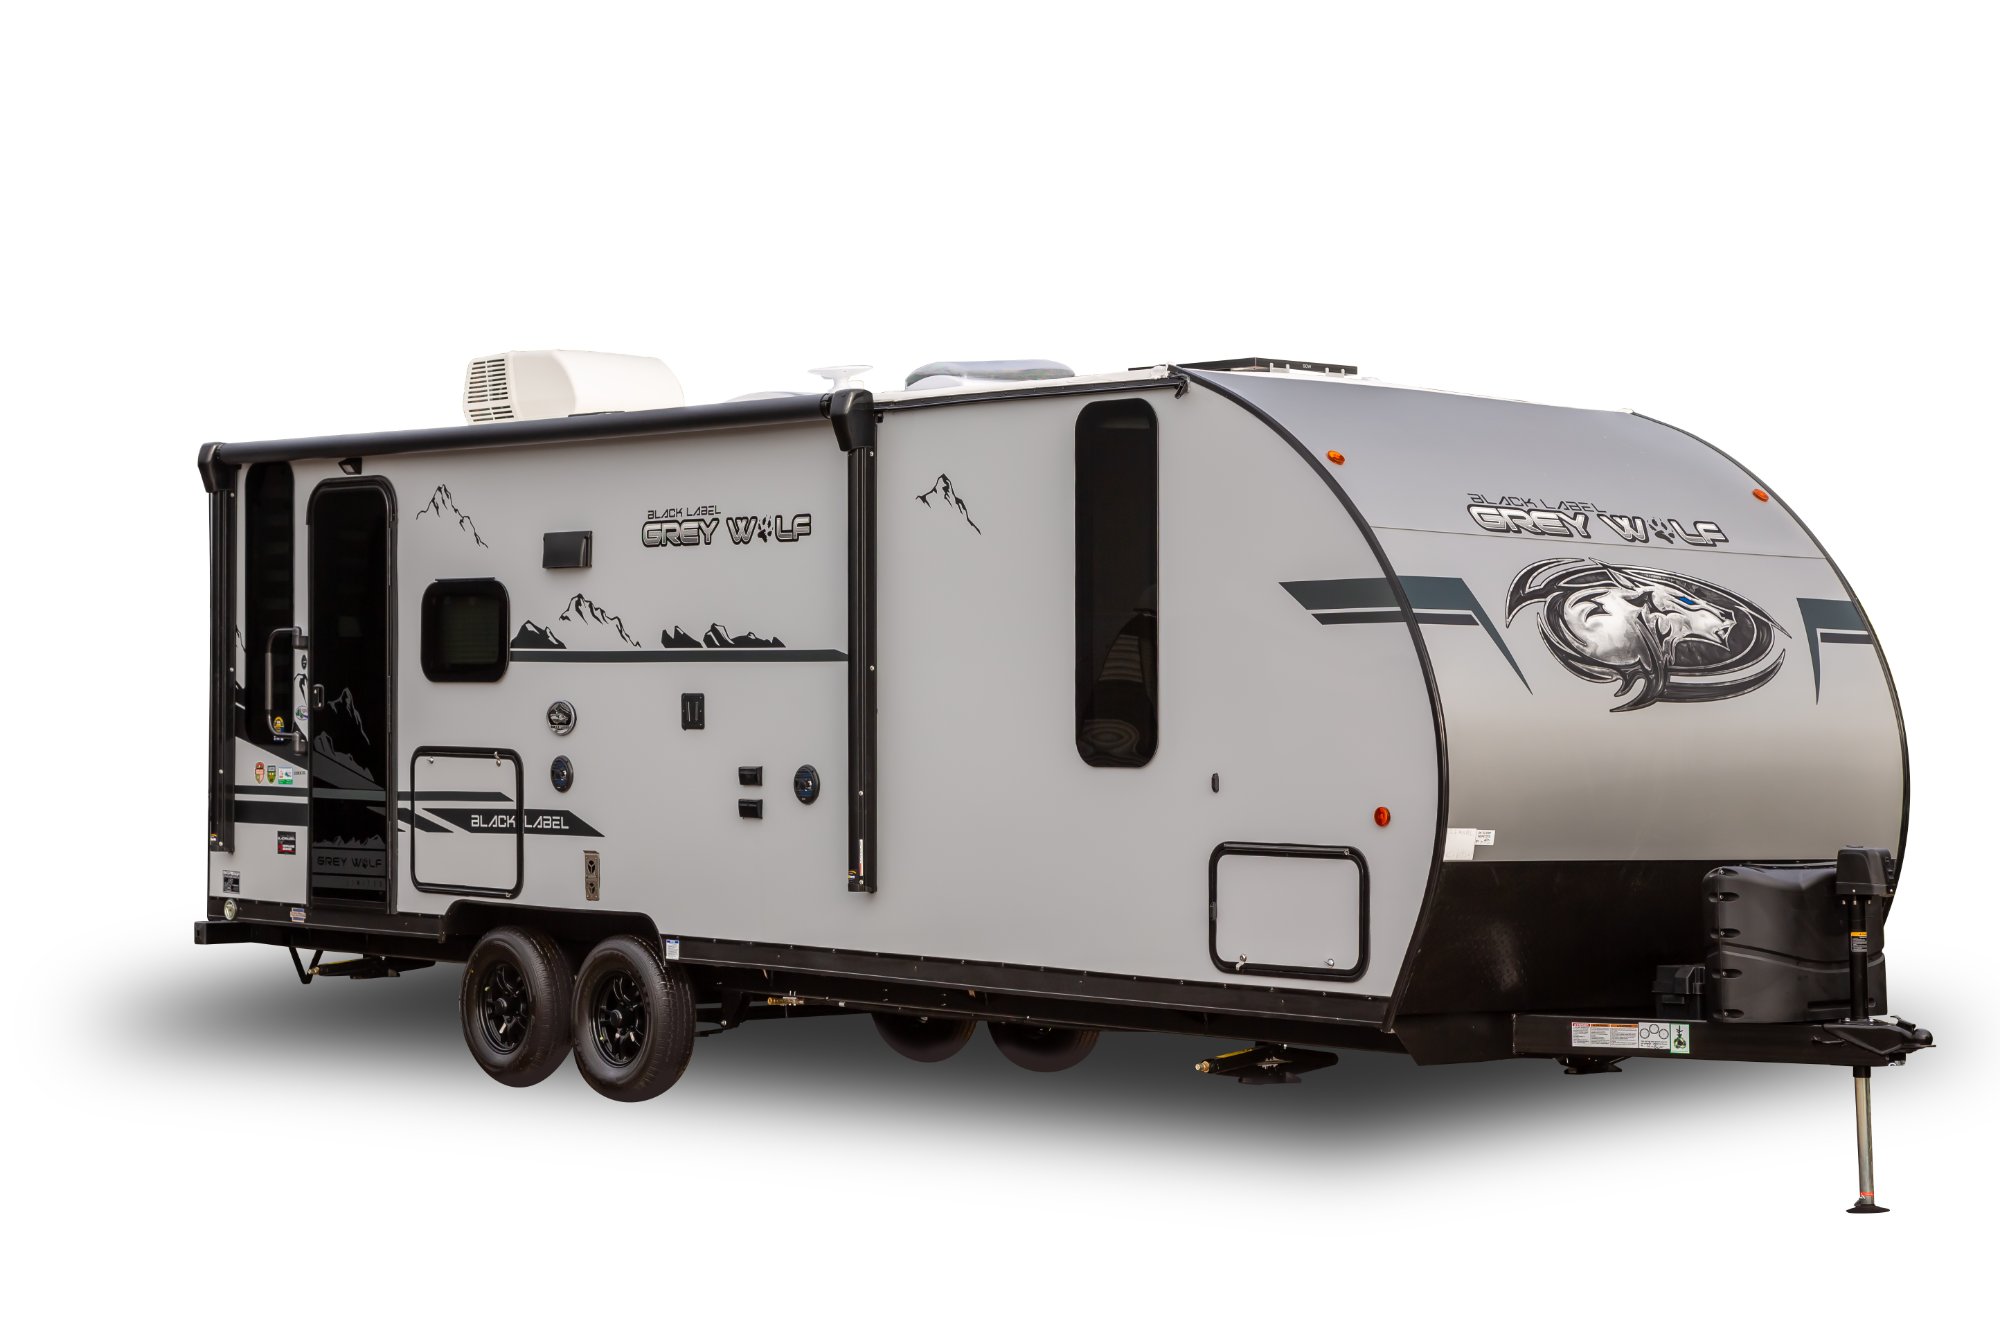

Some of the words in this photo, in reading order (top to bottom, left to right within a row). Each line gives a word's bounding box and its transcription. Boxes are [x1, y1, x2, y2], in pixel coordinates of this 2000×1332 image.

[1467, 493, 1538, 508] BLACK
[1540, 498, 1607, 513] LABEL
[647, 508, 683, 520] BLACK
[686, 505, 722, 517] LABEL
[1467, 504, 1591, 539] GREY
[641, 518, 720, 548] GREY
[471, 815, 517, 828] BLACK
[524, 815, 569, 829] LABEL
[317, 856, 347, 867] GREY
